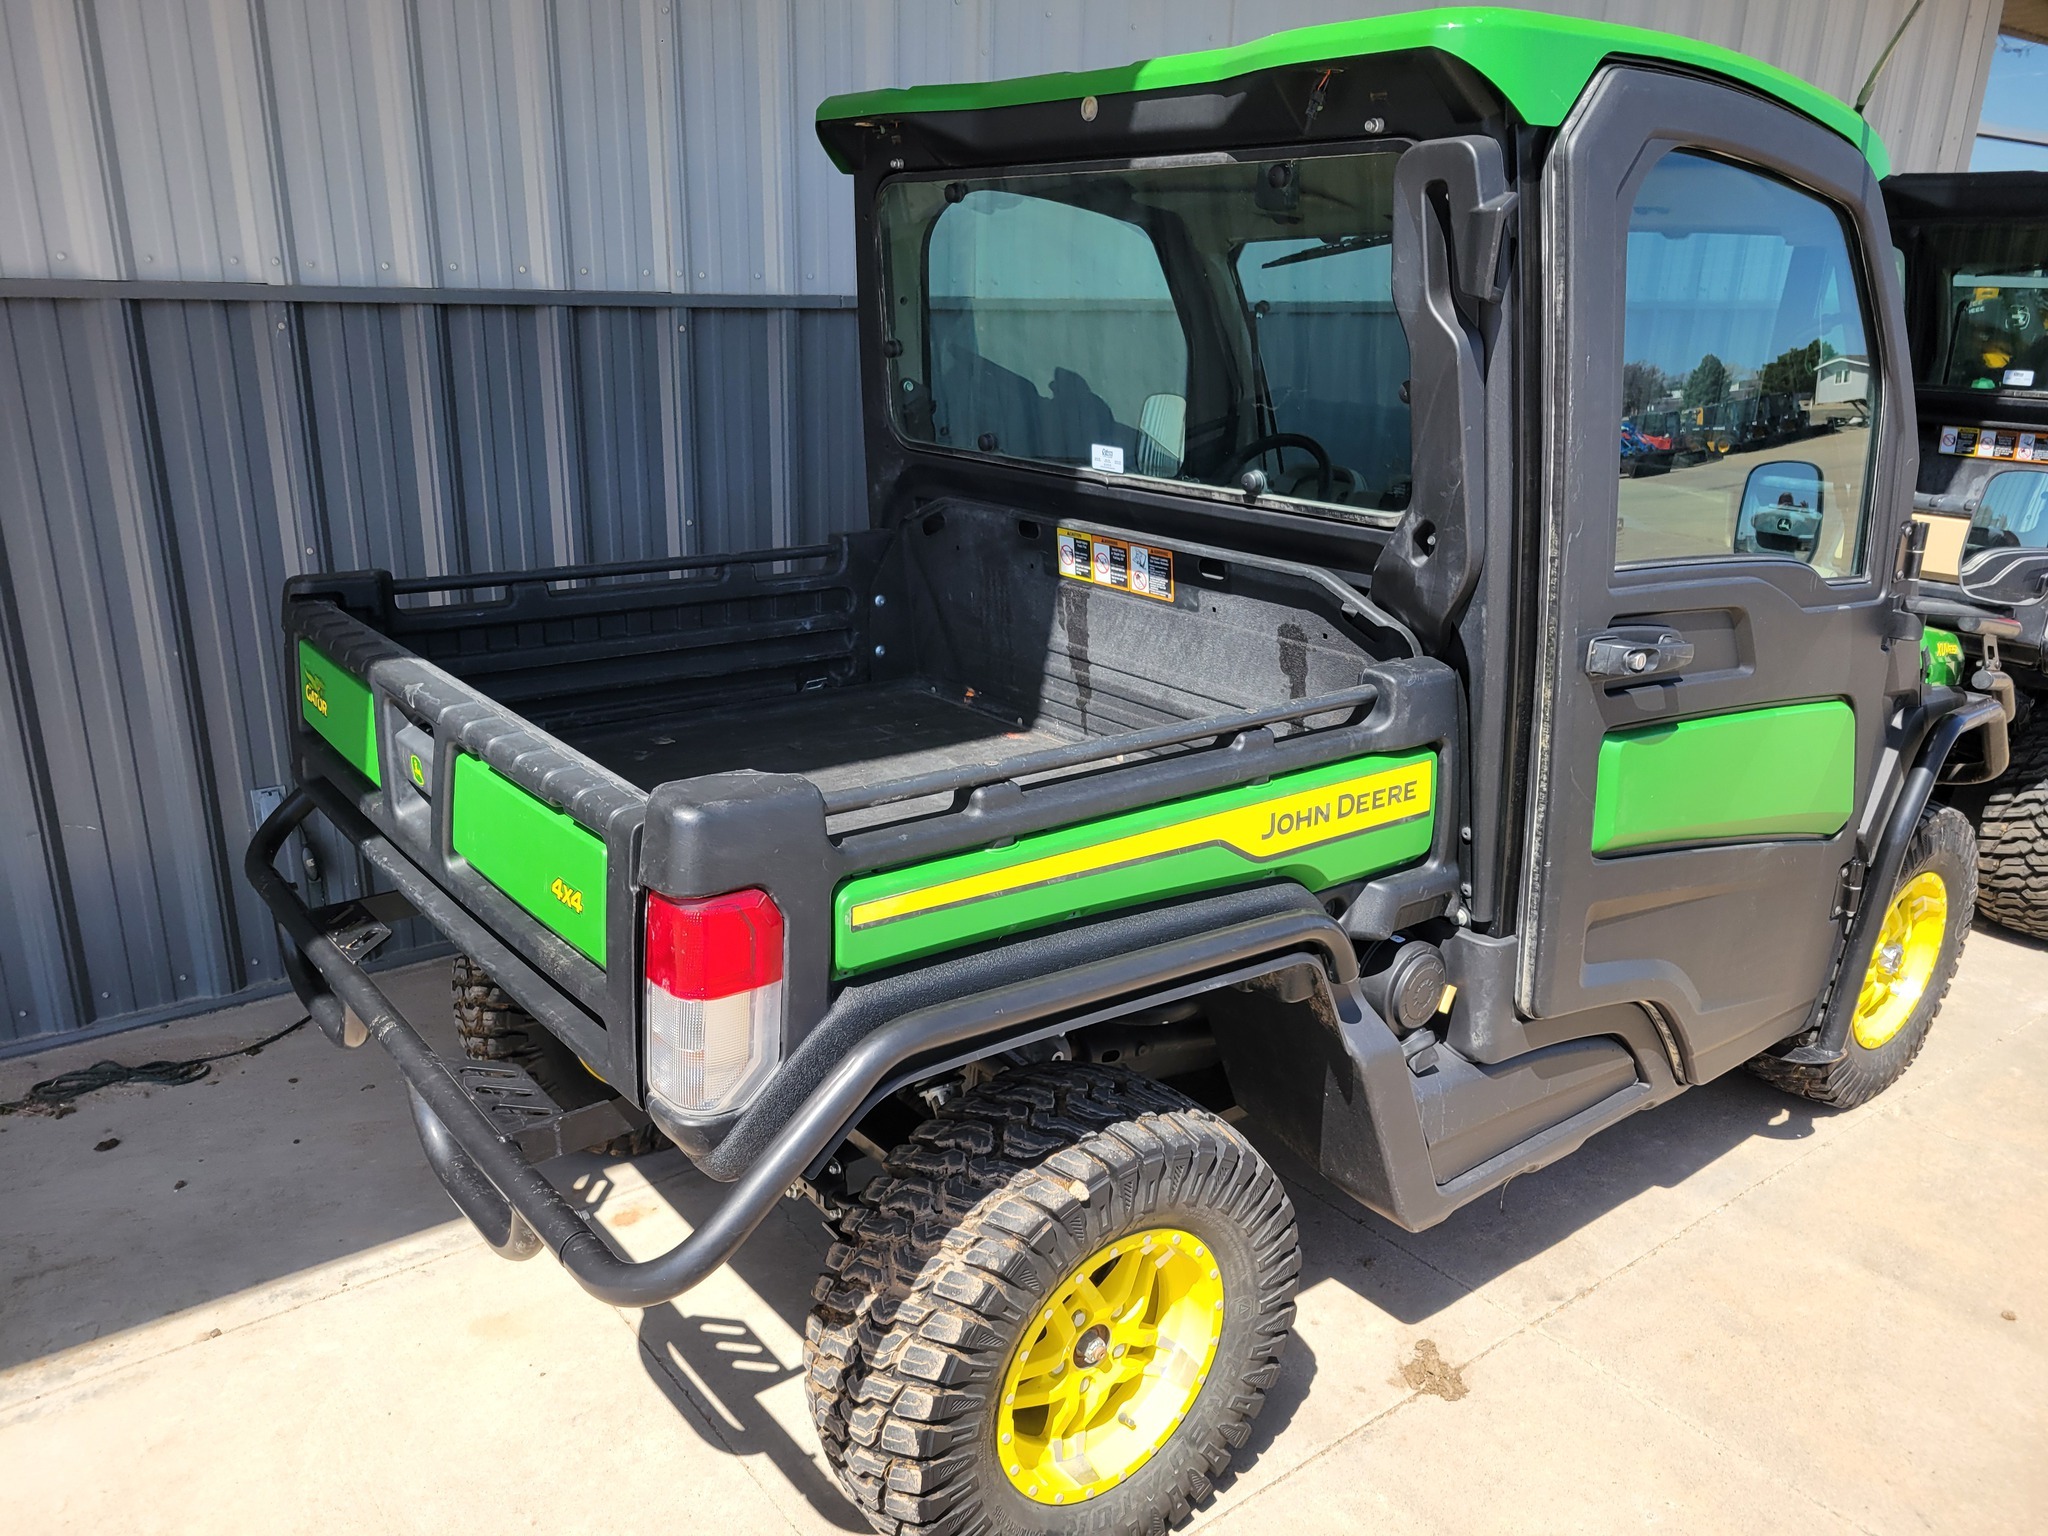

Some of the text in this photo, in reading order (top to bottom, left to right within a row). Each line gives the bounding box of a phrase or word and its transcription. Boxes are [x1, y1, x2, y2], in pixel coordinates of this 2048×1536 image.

[305, 683, 328, 716] GATOR
[1262, 780, 1418, 839] JOHN DEERE
